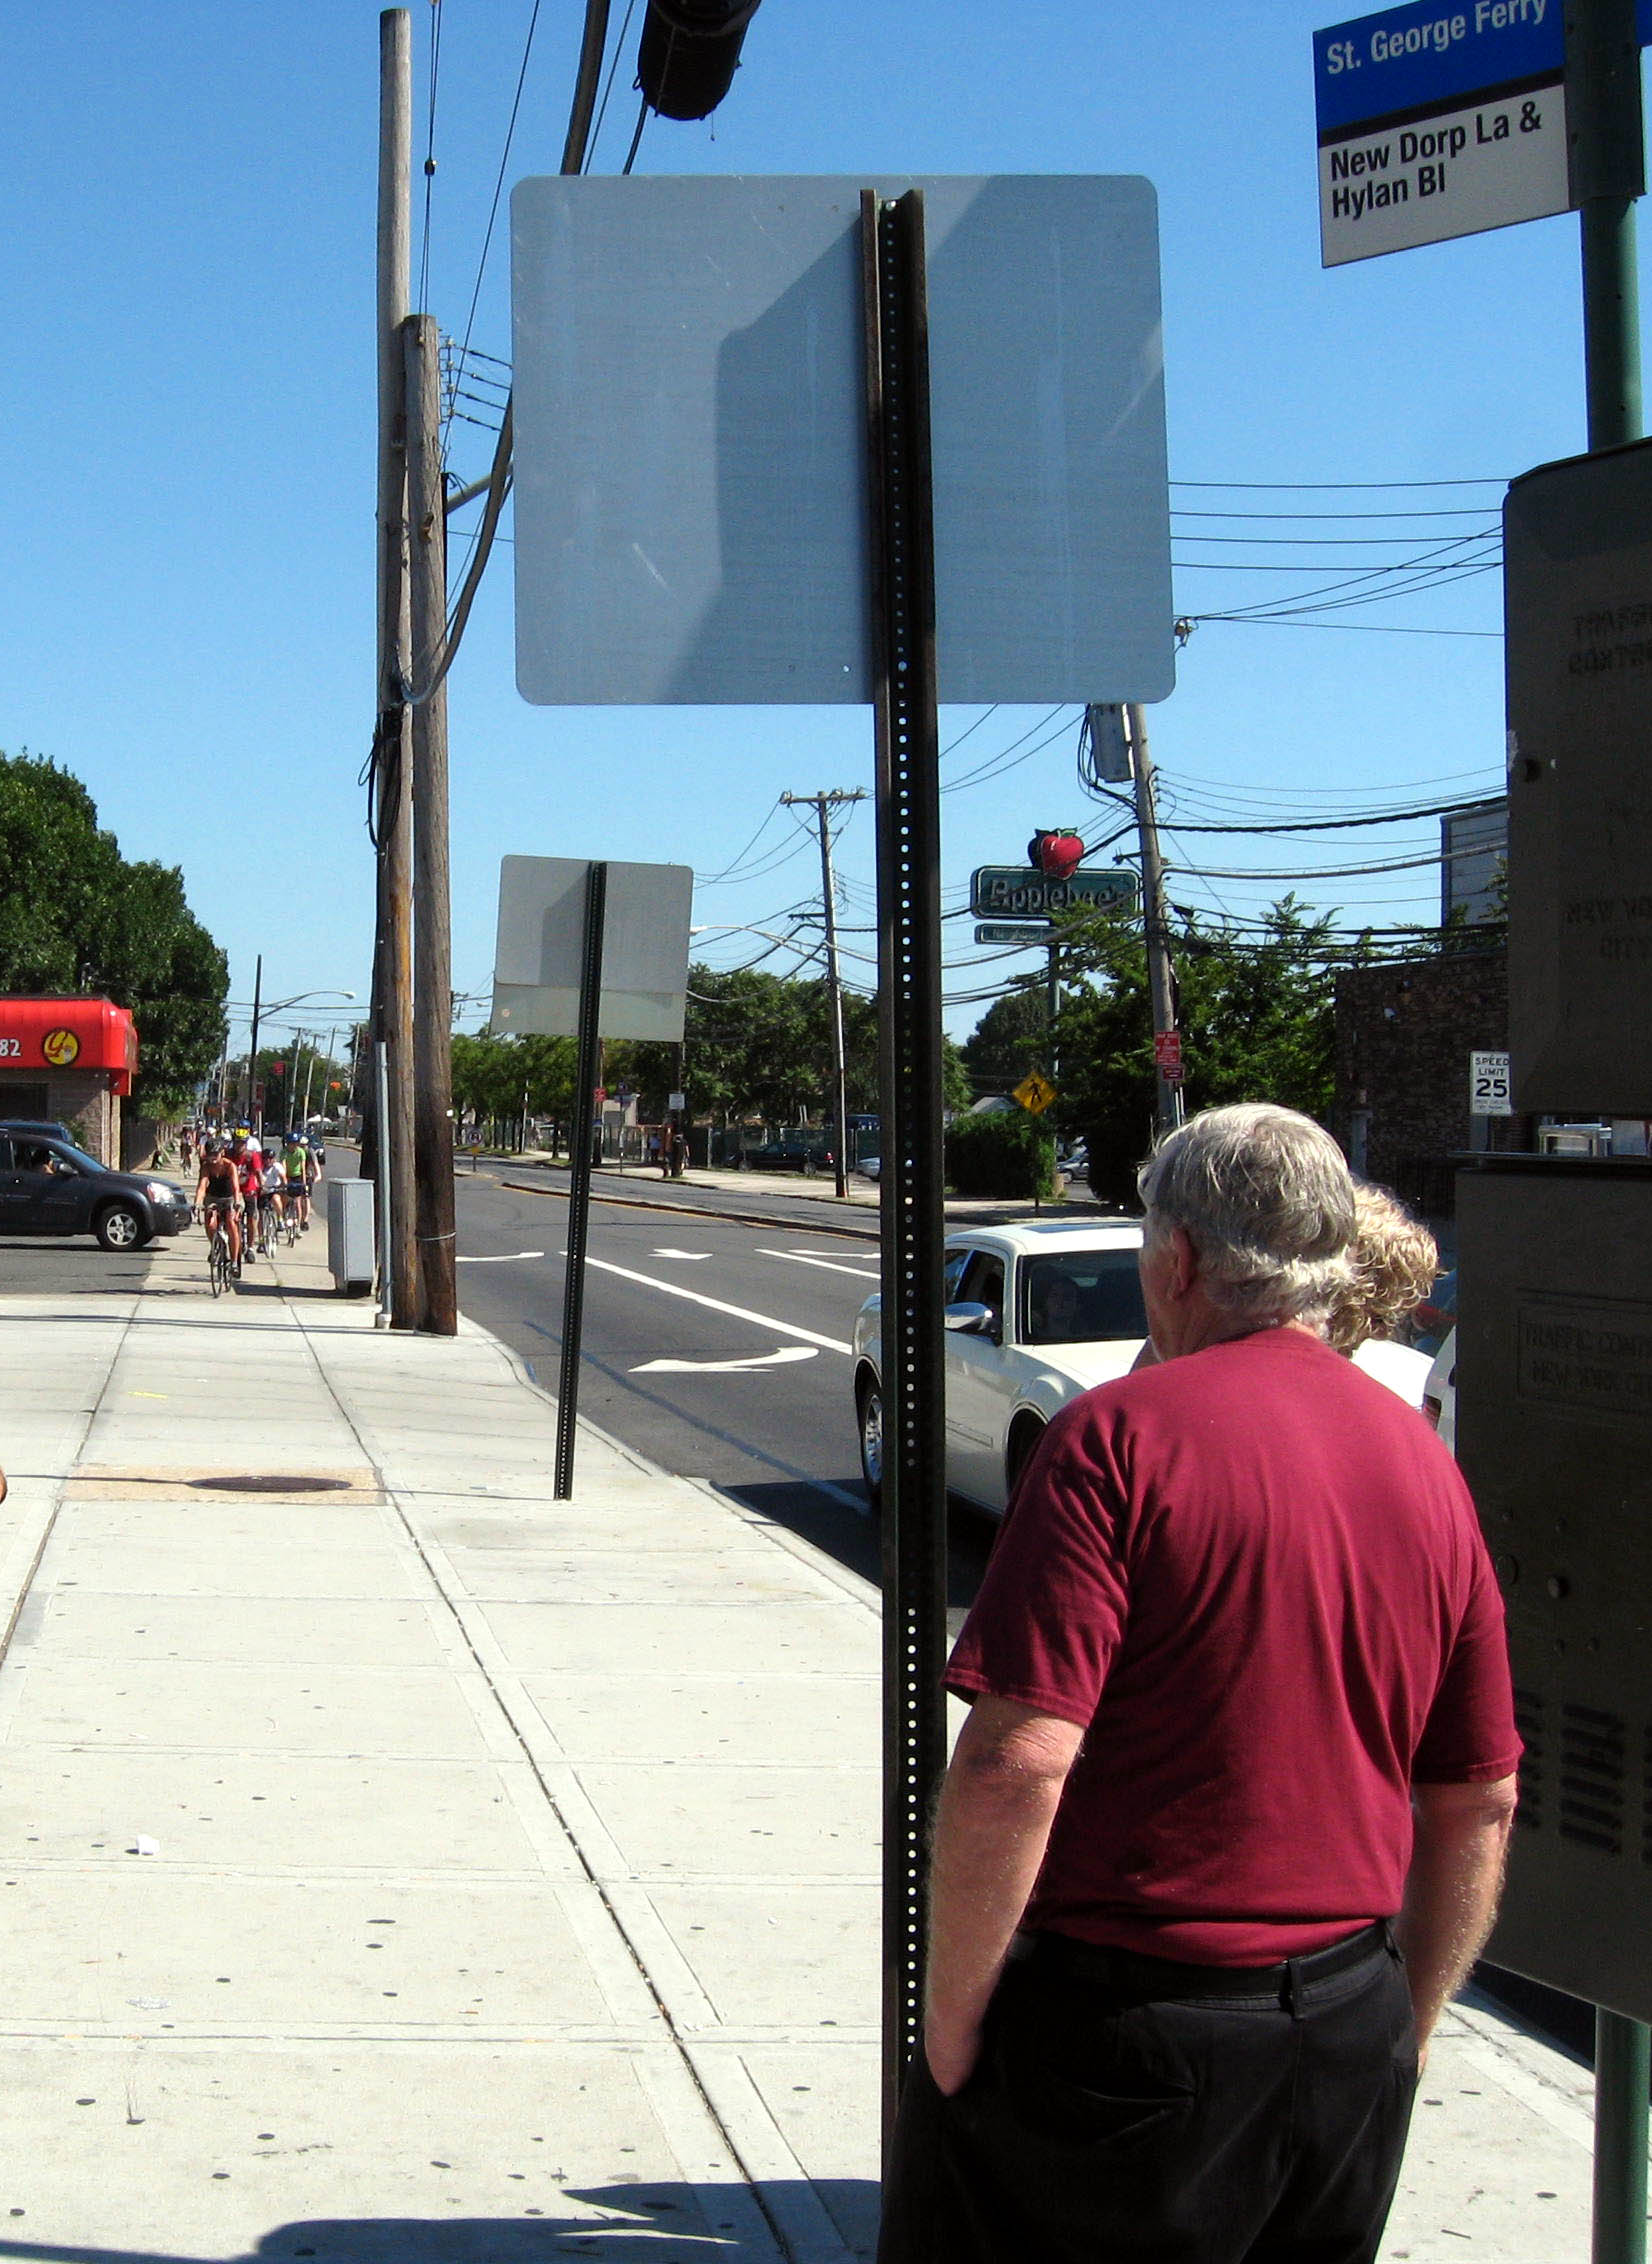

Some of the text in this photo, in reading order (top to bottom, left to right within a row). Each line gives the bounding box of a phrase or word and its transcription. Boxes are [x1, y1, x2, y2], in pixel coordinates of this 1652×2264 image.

[1327, 0, 1547, 75] St. George Ferry
[1330, 100, 1542, 181] New Dorp La &
[1332, 162, 1446, 221] Hylan Bl
[1475, 1057, 1510, 1066] SPEED
[1478, 1068, 1504, 1077] LIMIT
[1476, 1078, 1508, 1098] 25
